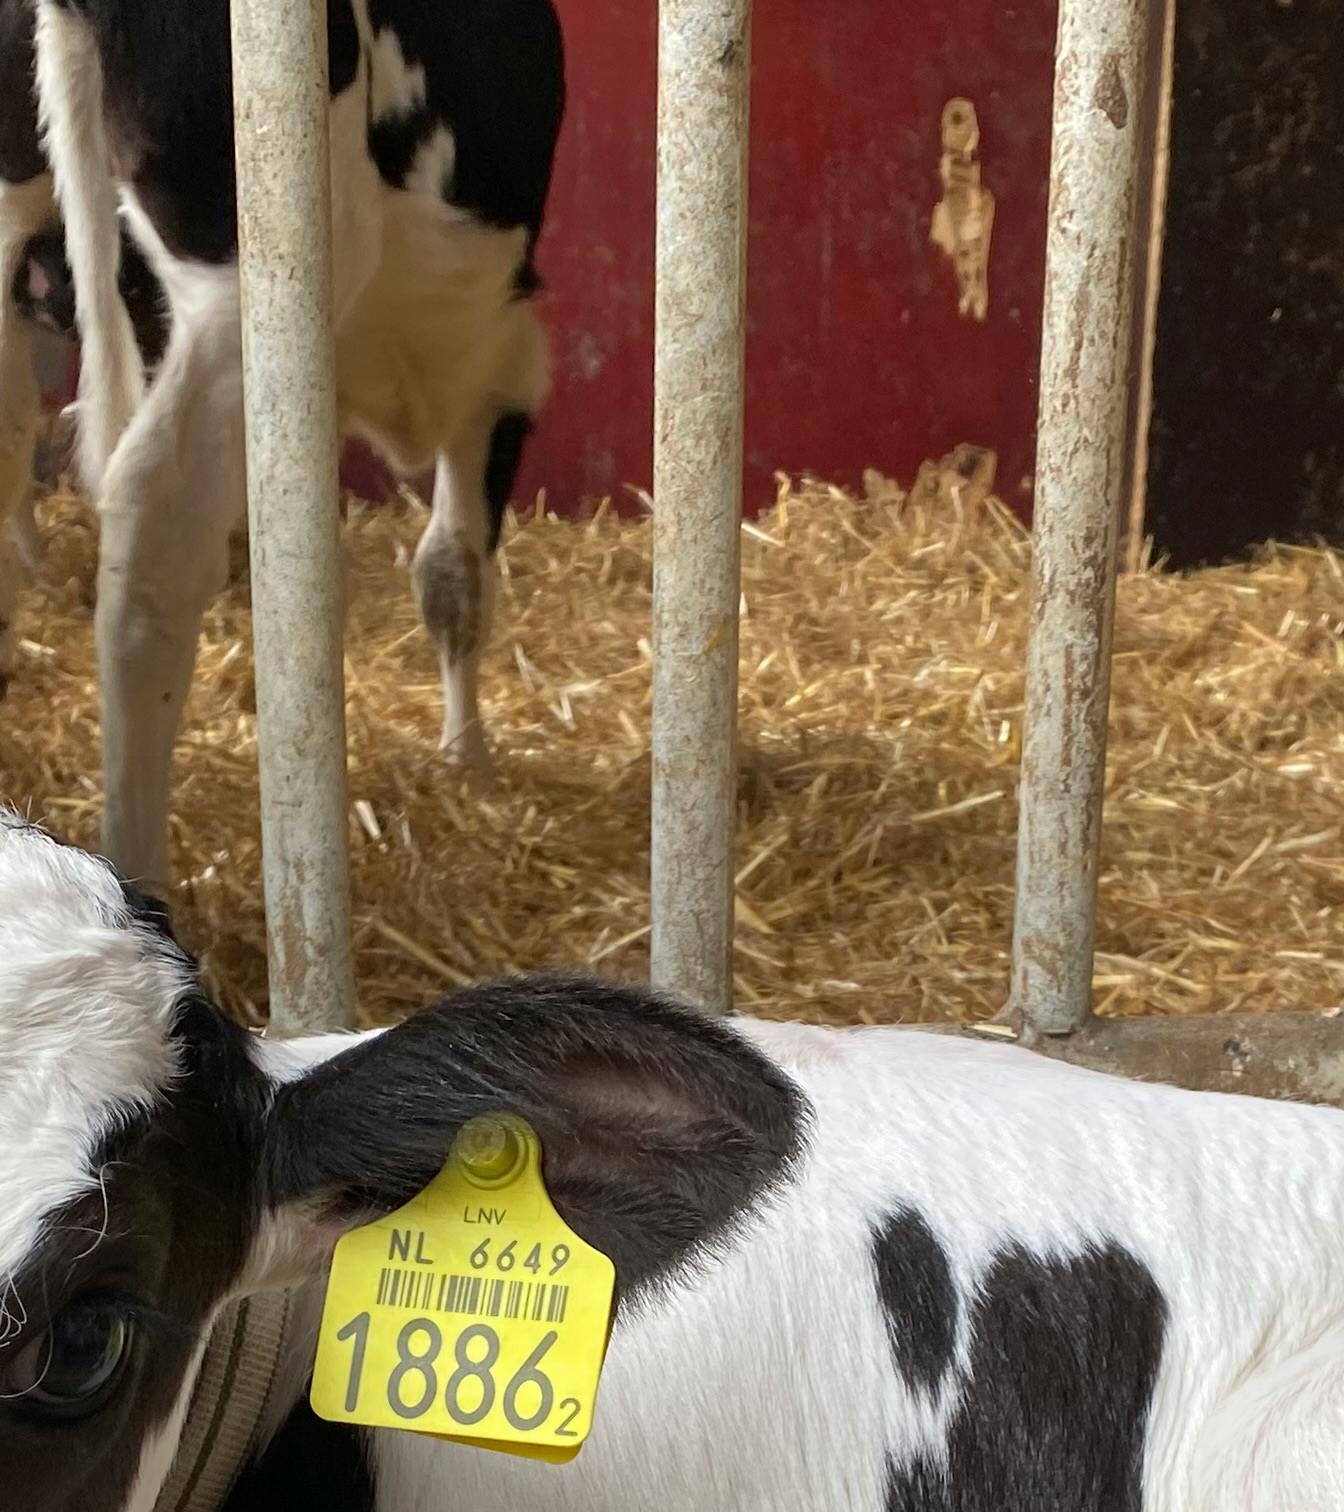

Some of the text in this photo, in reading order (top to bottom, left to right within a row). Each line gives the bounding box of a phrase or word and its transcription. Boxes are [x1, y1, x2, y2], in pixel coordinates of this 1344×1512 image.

[463, 1205, 507, 1226] LNV
[387, 1228, 571, 1277] NL 6649
[336, 1310, 558, 1432] 1886
